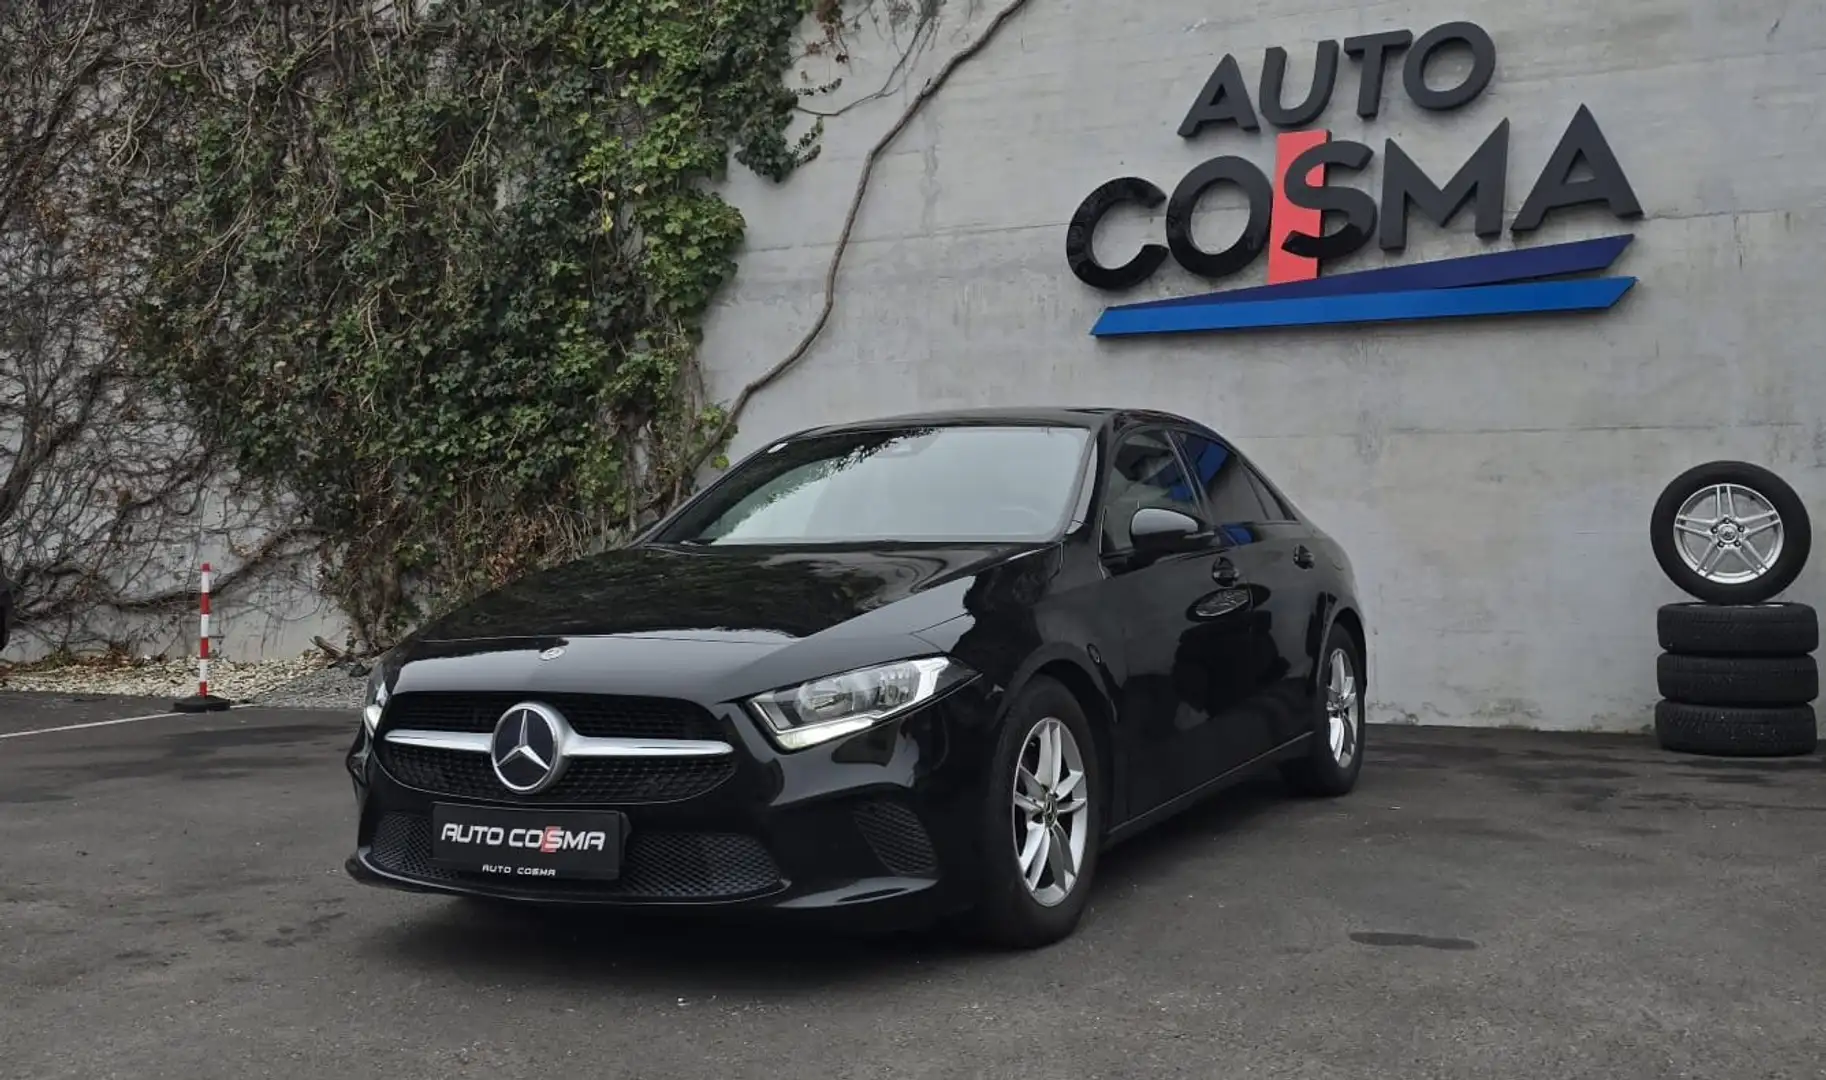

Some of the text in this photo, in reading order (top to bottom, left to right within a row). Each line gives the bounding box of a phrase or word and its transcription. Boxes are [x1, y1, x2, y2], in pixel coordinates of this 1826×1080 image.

[1177, 21, 1496, 140] AUTO
[1066, 102, 1644, 290] COSMA
[441, 823, 606, 851] AUTO COSMA
[482, 863, 556, 877] AUTO COSMA
